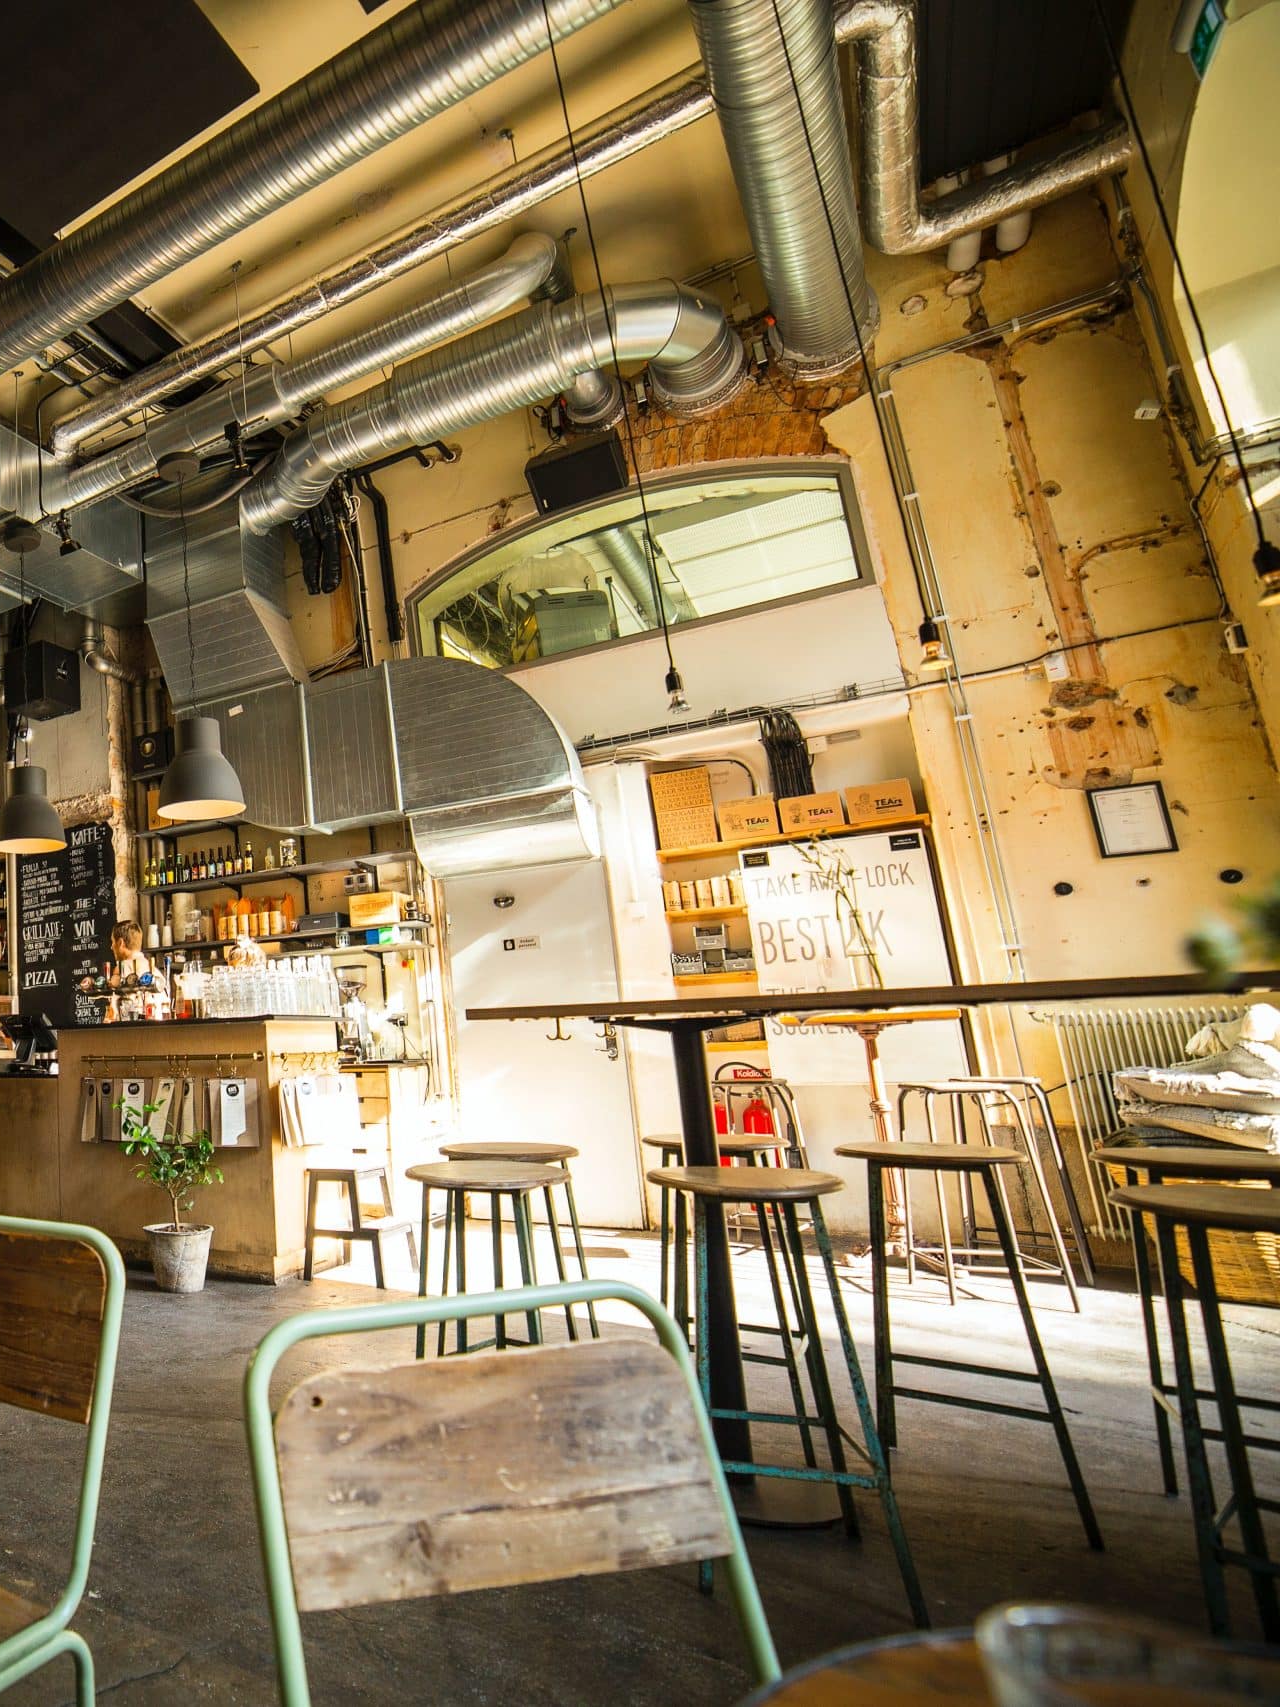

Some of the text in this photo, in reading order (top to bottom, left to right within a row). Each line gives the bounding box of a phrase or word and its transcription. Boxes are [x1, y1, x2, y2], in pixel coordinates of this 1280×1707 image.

[875, 797, 903, 807] TEArs
[745, 816, 769, 826] TEArs
[807, 807, 833, 817] TEArs
[752, 876, 803, 899] TAKE
[74, 919, 95, 937] VIN
[758, 909, 893, 965] BESTIK
[24, 969, 57, 987] PIZZA
